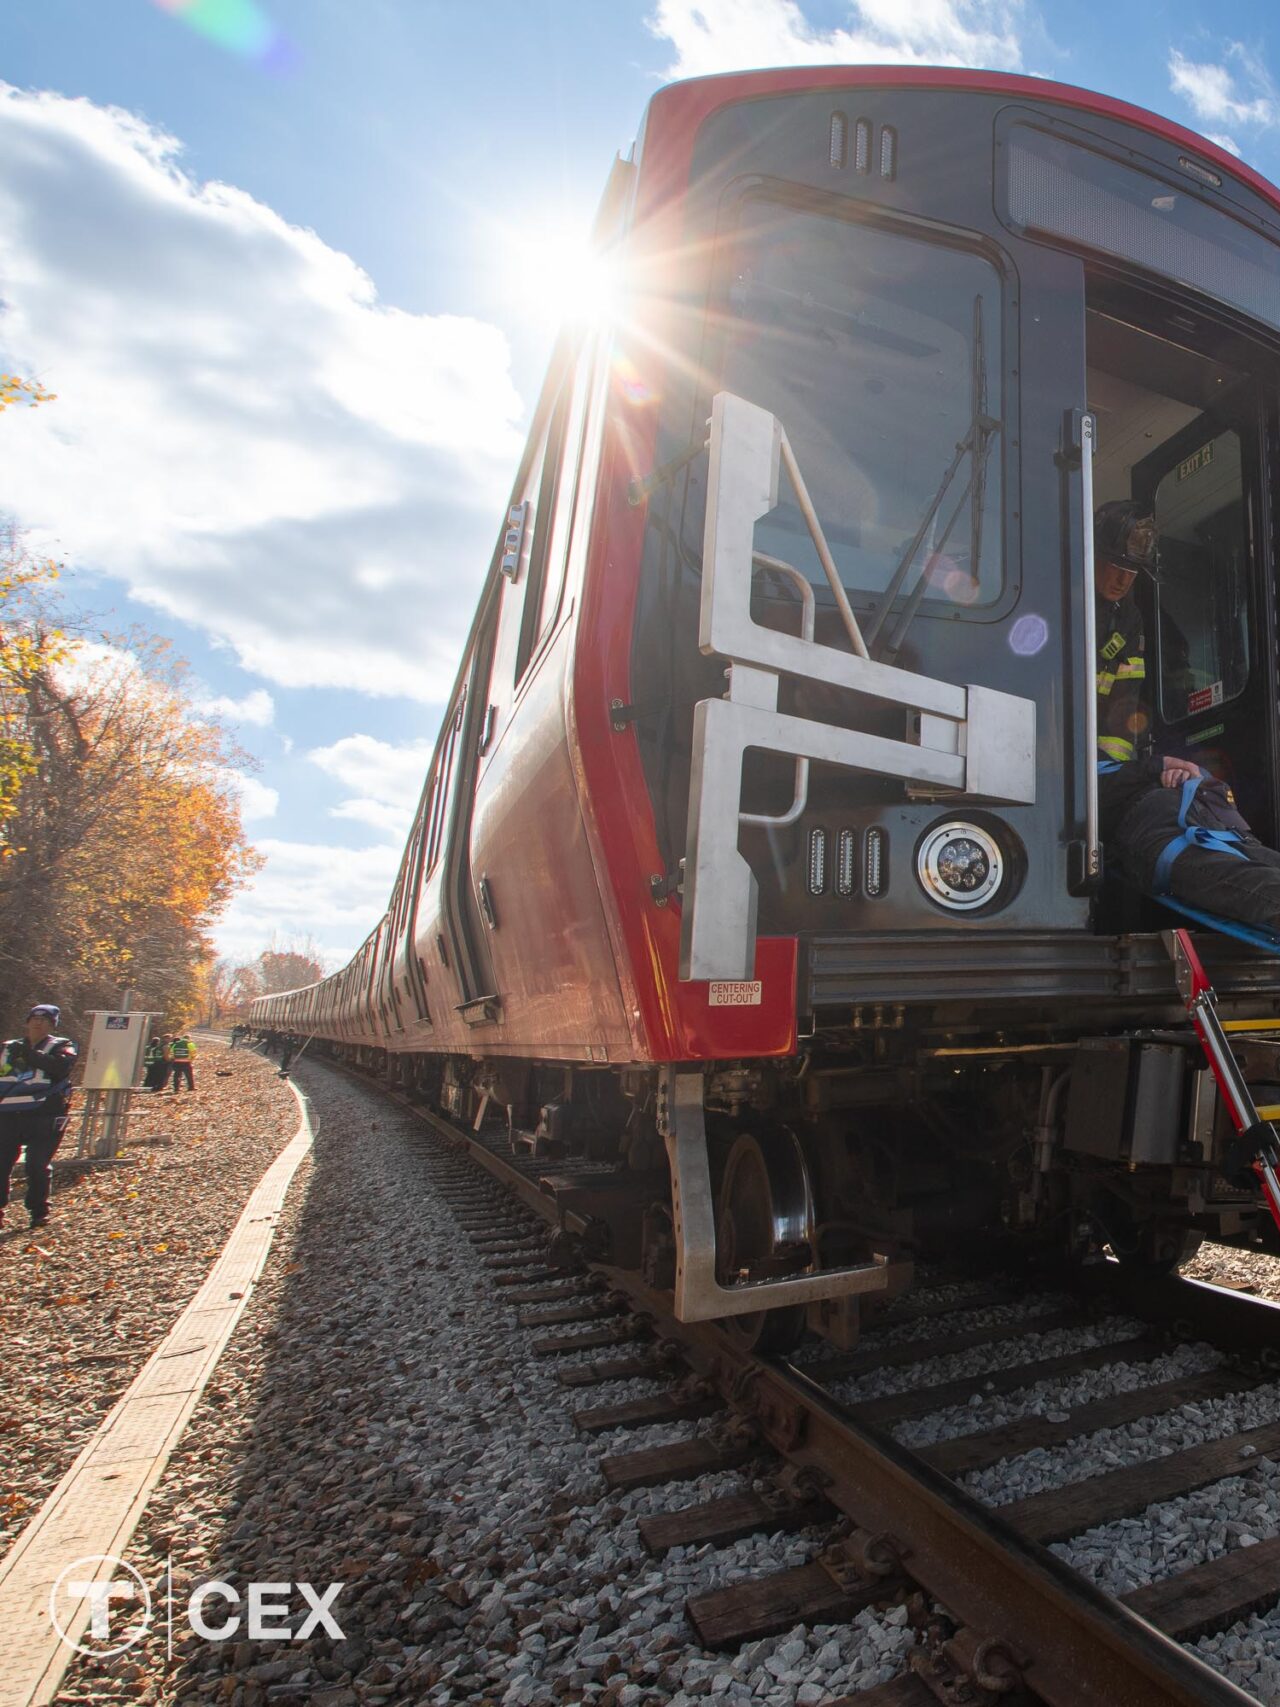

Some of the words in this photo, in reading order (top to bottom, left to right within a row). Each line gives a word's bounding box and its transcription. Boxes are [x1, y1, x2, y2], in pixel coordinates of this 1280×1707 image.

[1180, 453, 1200, 480] EXIT
[711, 983, 760, 993] CENTERING
[716, 994, 754, 1004] CUT-OUT
